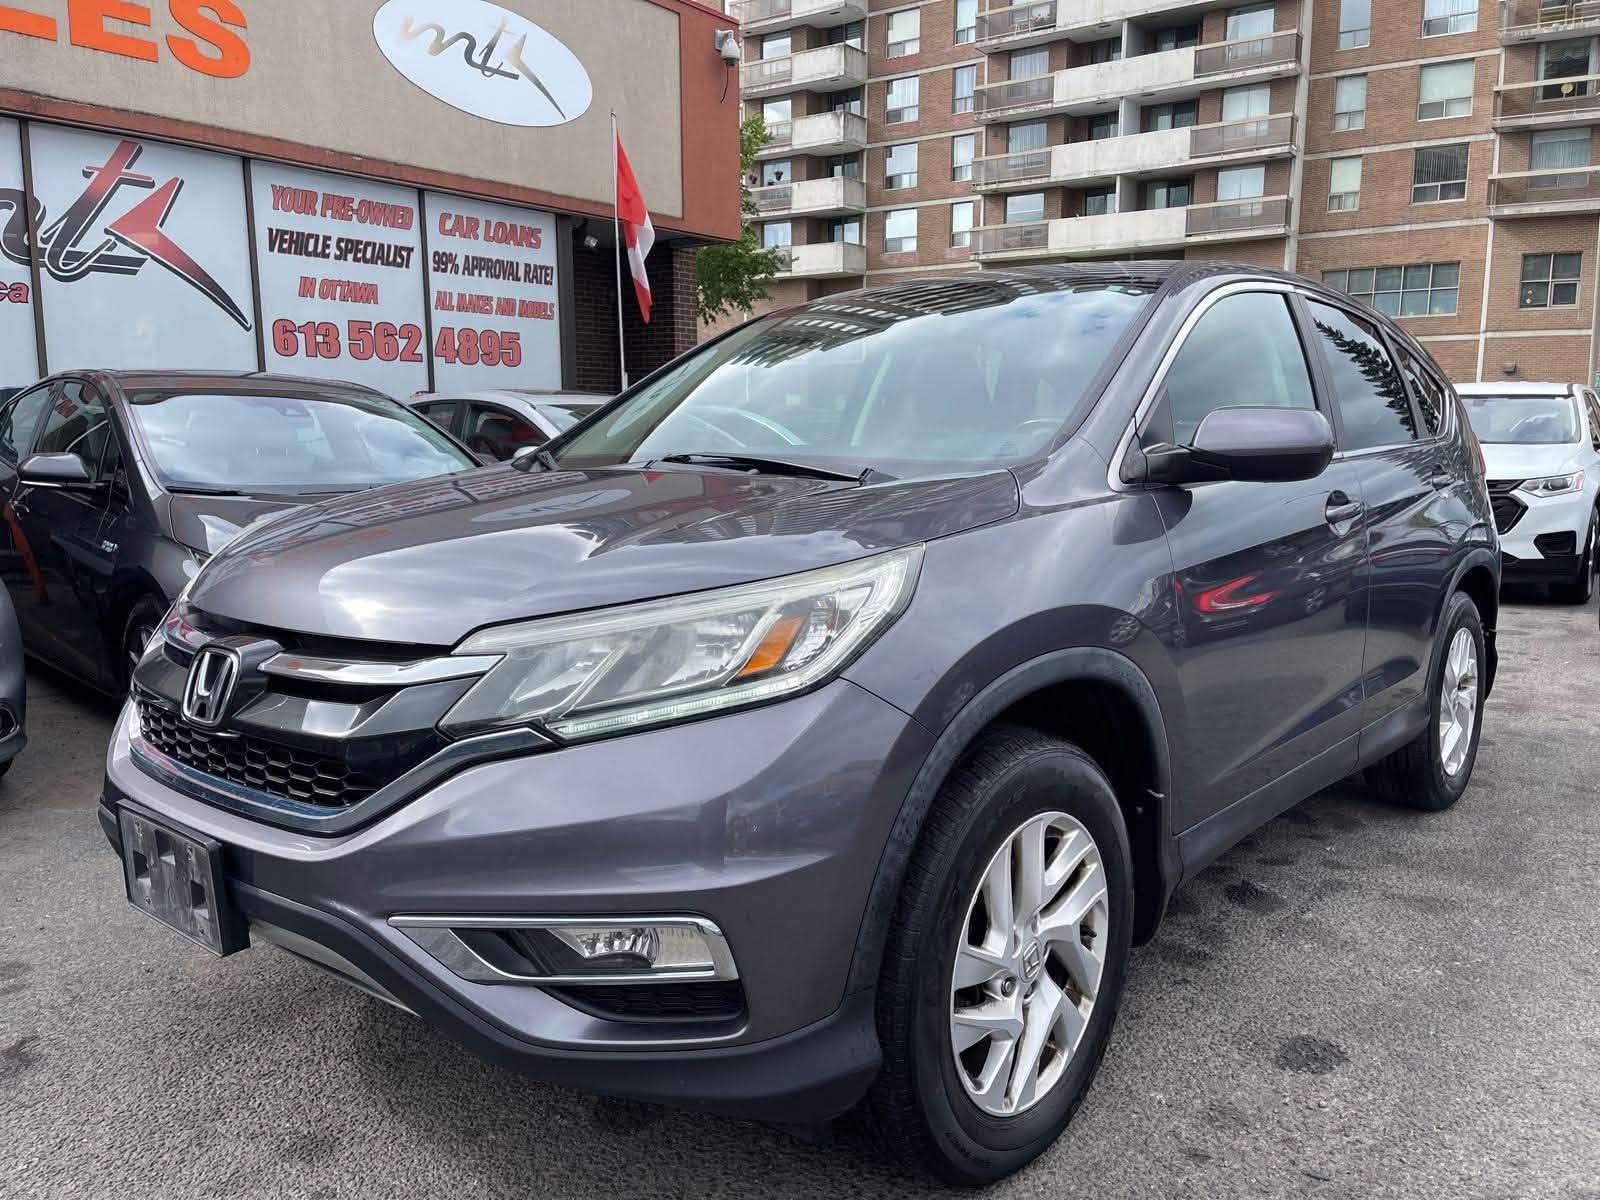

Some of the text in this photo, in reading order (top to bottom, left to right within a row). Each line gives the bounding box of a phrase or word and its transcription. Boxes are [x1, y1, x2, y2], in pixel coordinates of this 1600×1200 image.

[271, 184, 414, 231] YOUR PRE-OWNED
[267, 227, 415, 269] VEHICLE SPECIALIST
[438, 212, 542, 249] CAR LOANS
[432, 250, 554, 286] 99% APPROVAL RATE!
[298, 276, 379, 304] IN OTTAWA
[434, 290, 555, 320] ALL MAKES AND MODELS
[272, 318, 522, 367] 613 562 4895
